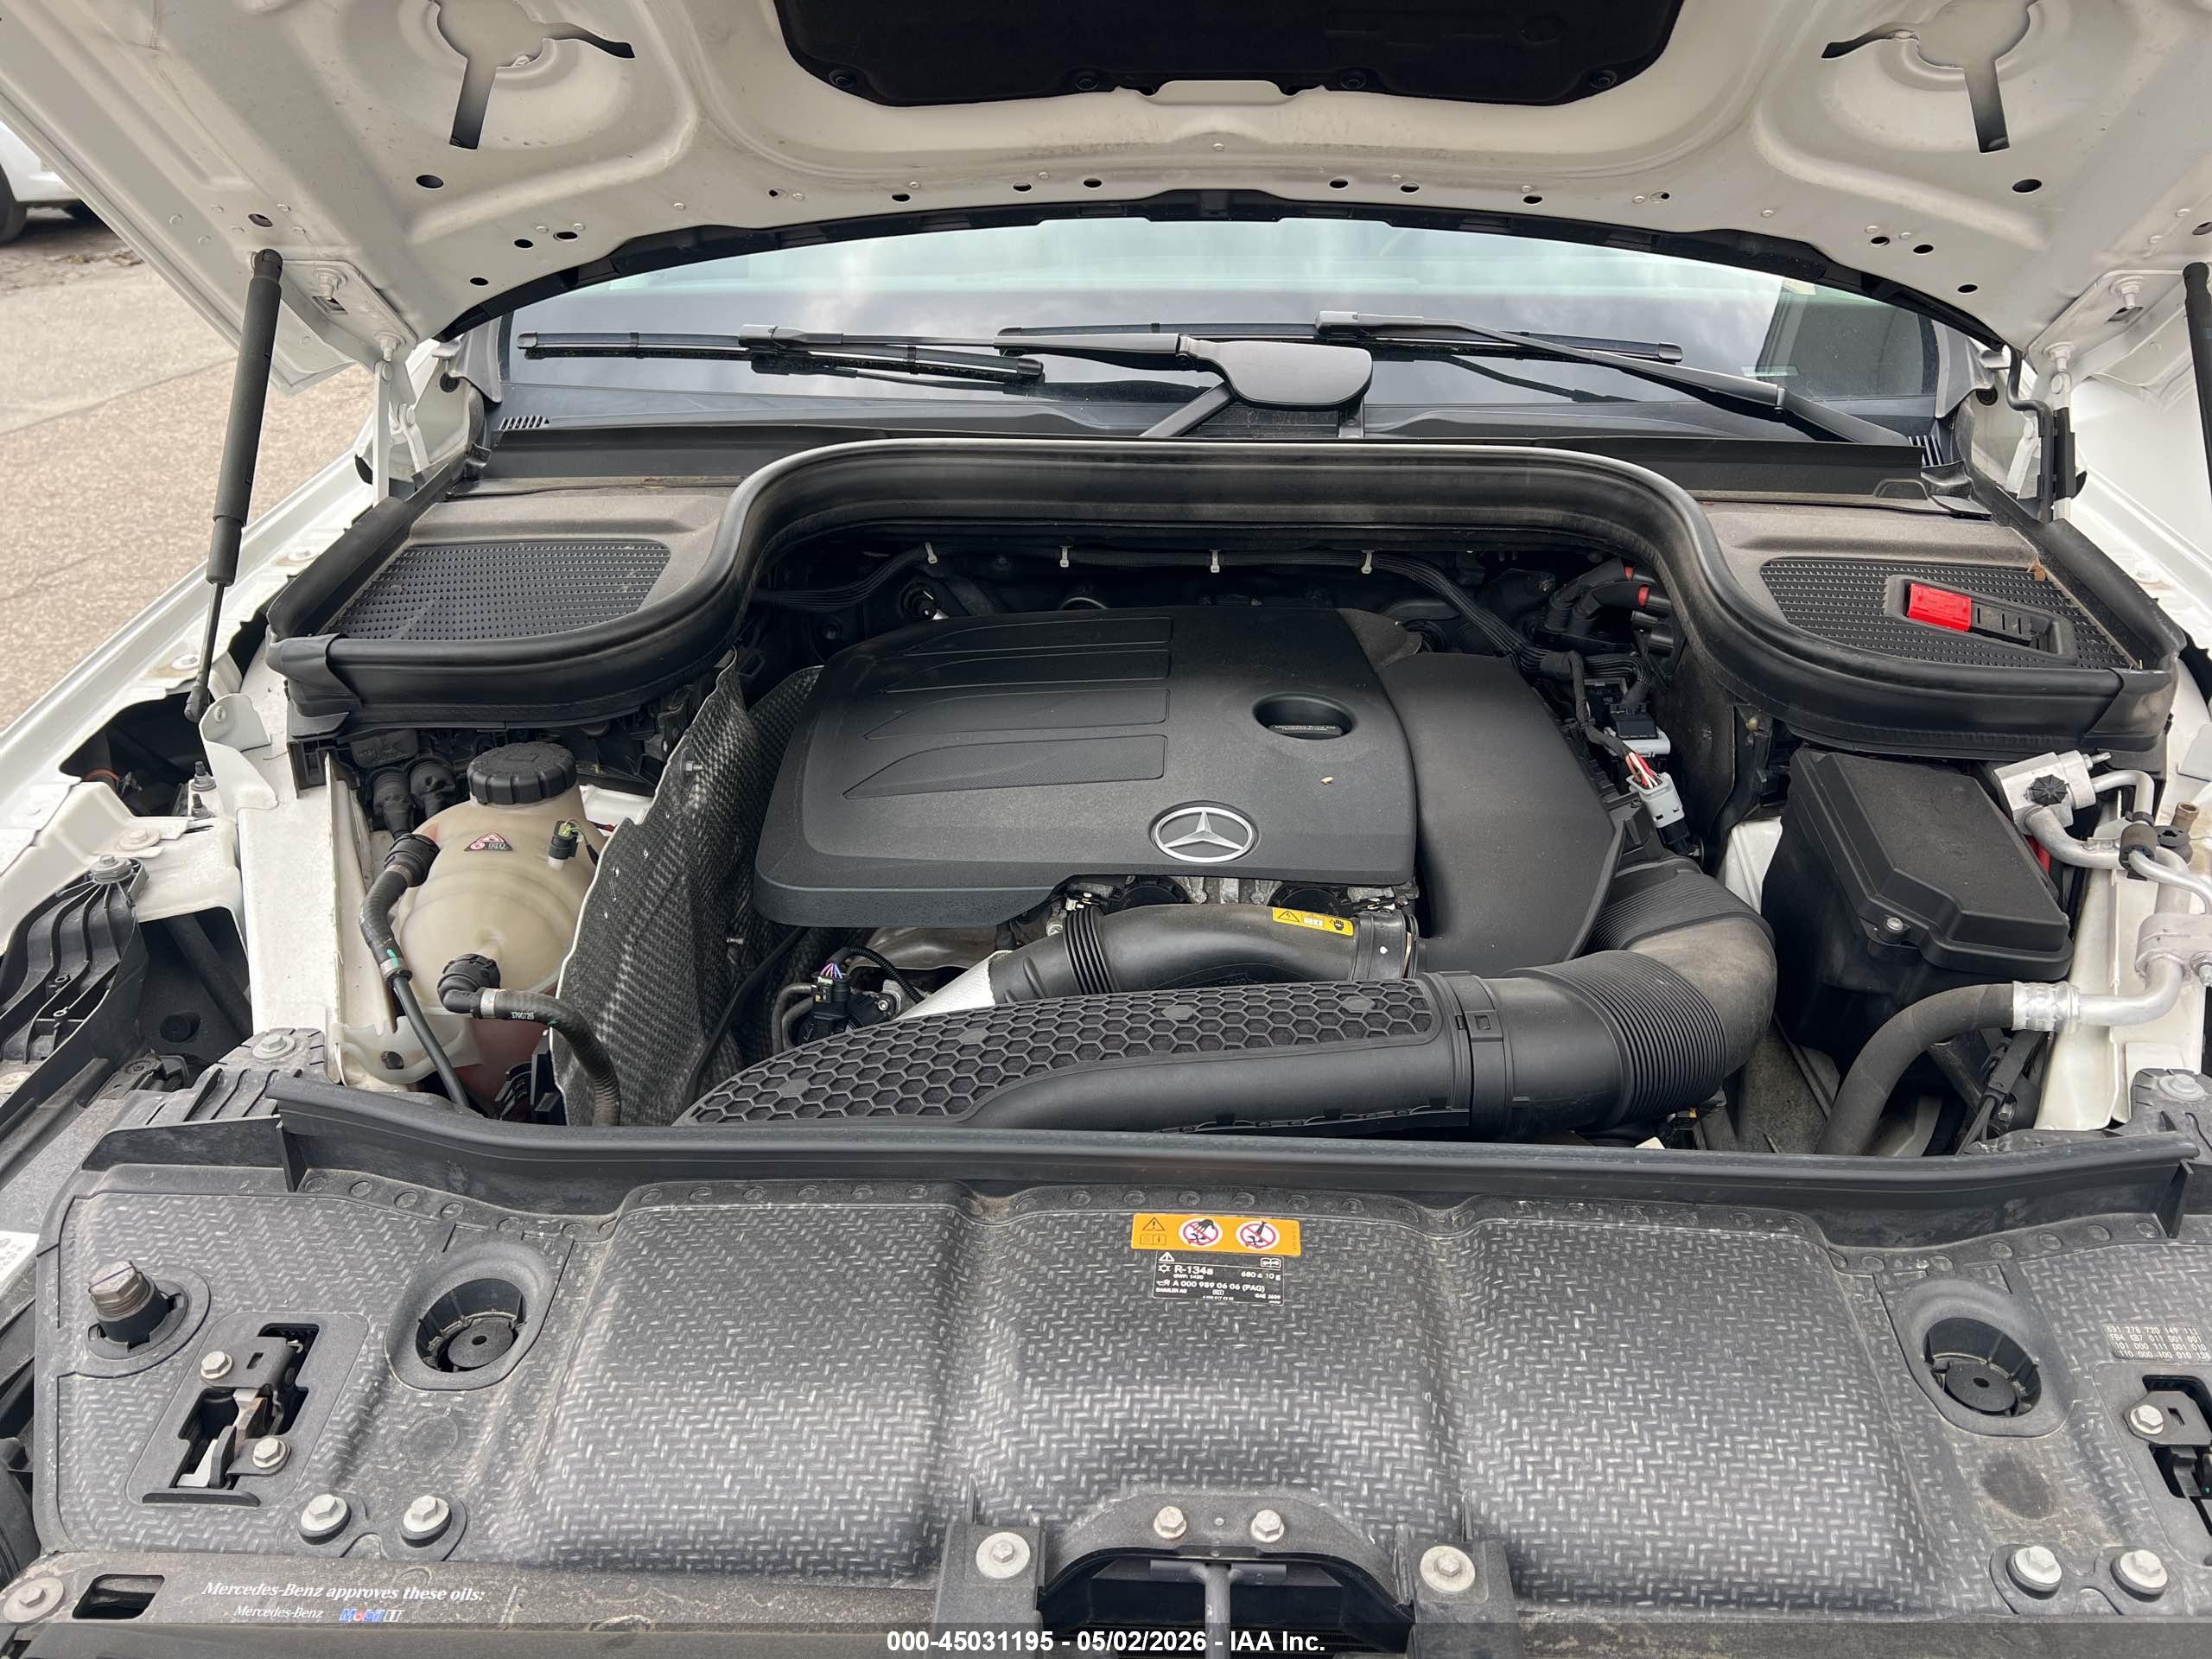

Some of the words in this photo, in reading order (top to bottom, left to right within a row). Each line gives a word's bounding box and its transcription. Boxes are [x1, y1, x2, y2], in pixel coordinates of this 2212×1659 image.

[1174, 1264, 1214, 1275] R-134a
[1242, 1284, 1265, 1294] (PAG)
[2115, 1341, 2130, 1350] 101
[2133, 1342, 2149, 1351] 000
[2190, 1343, 2207, 1351] 010
[200, 1582, 324, 1598] Mercedes-Benz
[325, 1586, 400, 1601] approves
[403, 1586, 448, 1600] these
[449, 1587, 486, 1602] oils:
[233, 1605, 325, 1619] Mercedes-Benz
[339, 1608, 385, 1623] Mobil
